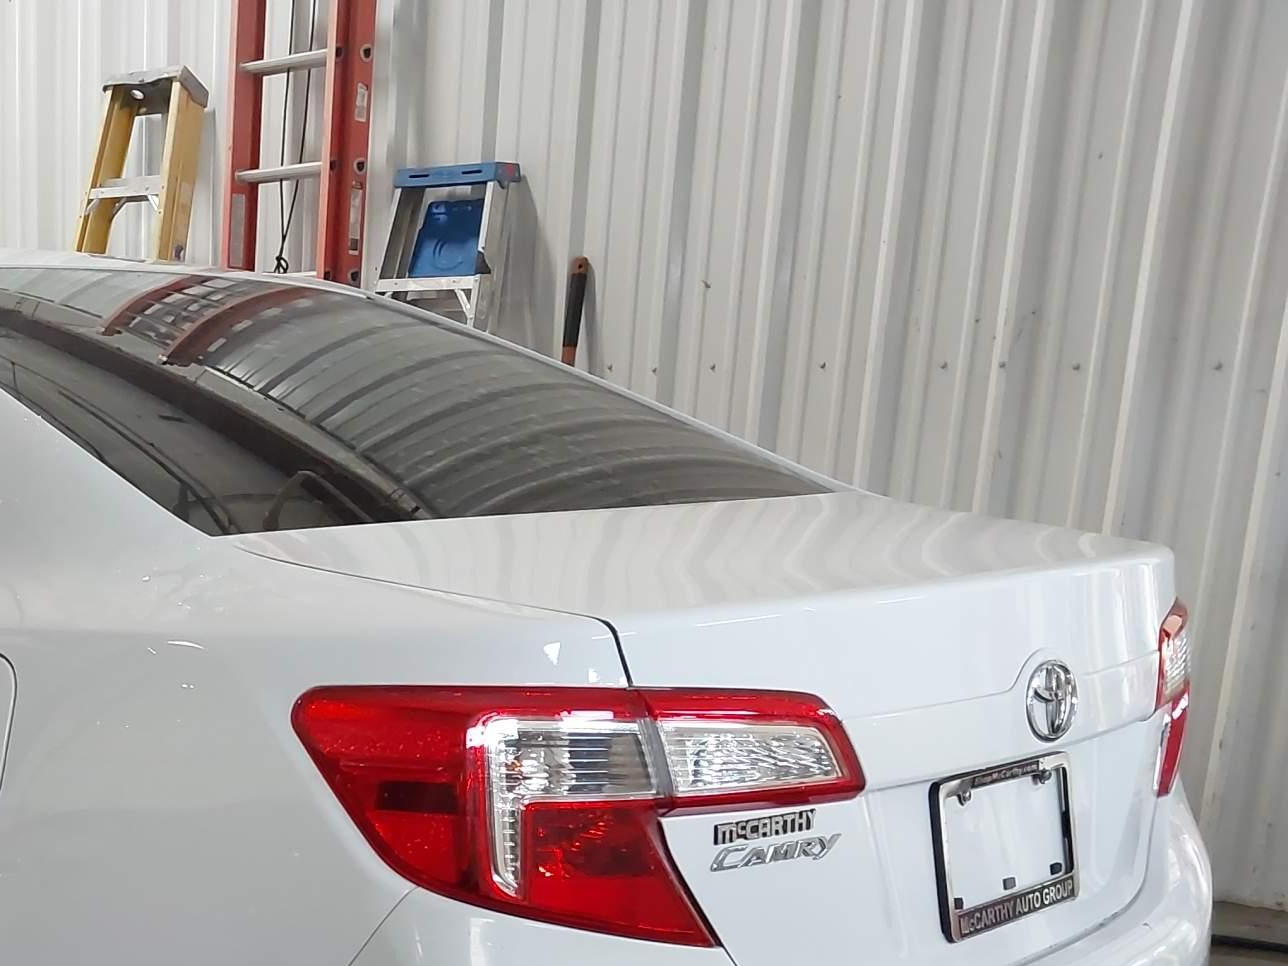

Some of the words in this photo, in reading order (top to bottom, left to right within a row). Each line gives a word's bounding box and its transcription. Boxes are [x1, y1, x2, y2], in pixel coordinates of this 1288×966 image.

[710, 833, 842, 872] CAMRY
[960, 901, 1013, 934] McCARTHY
[1016, 891, 1041, 915] AUTO
[1043, 879, 1073, 905] GROUP
